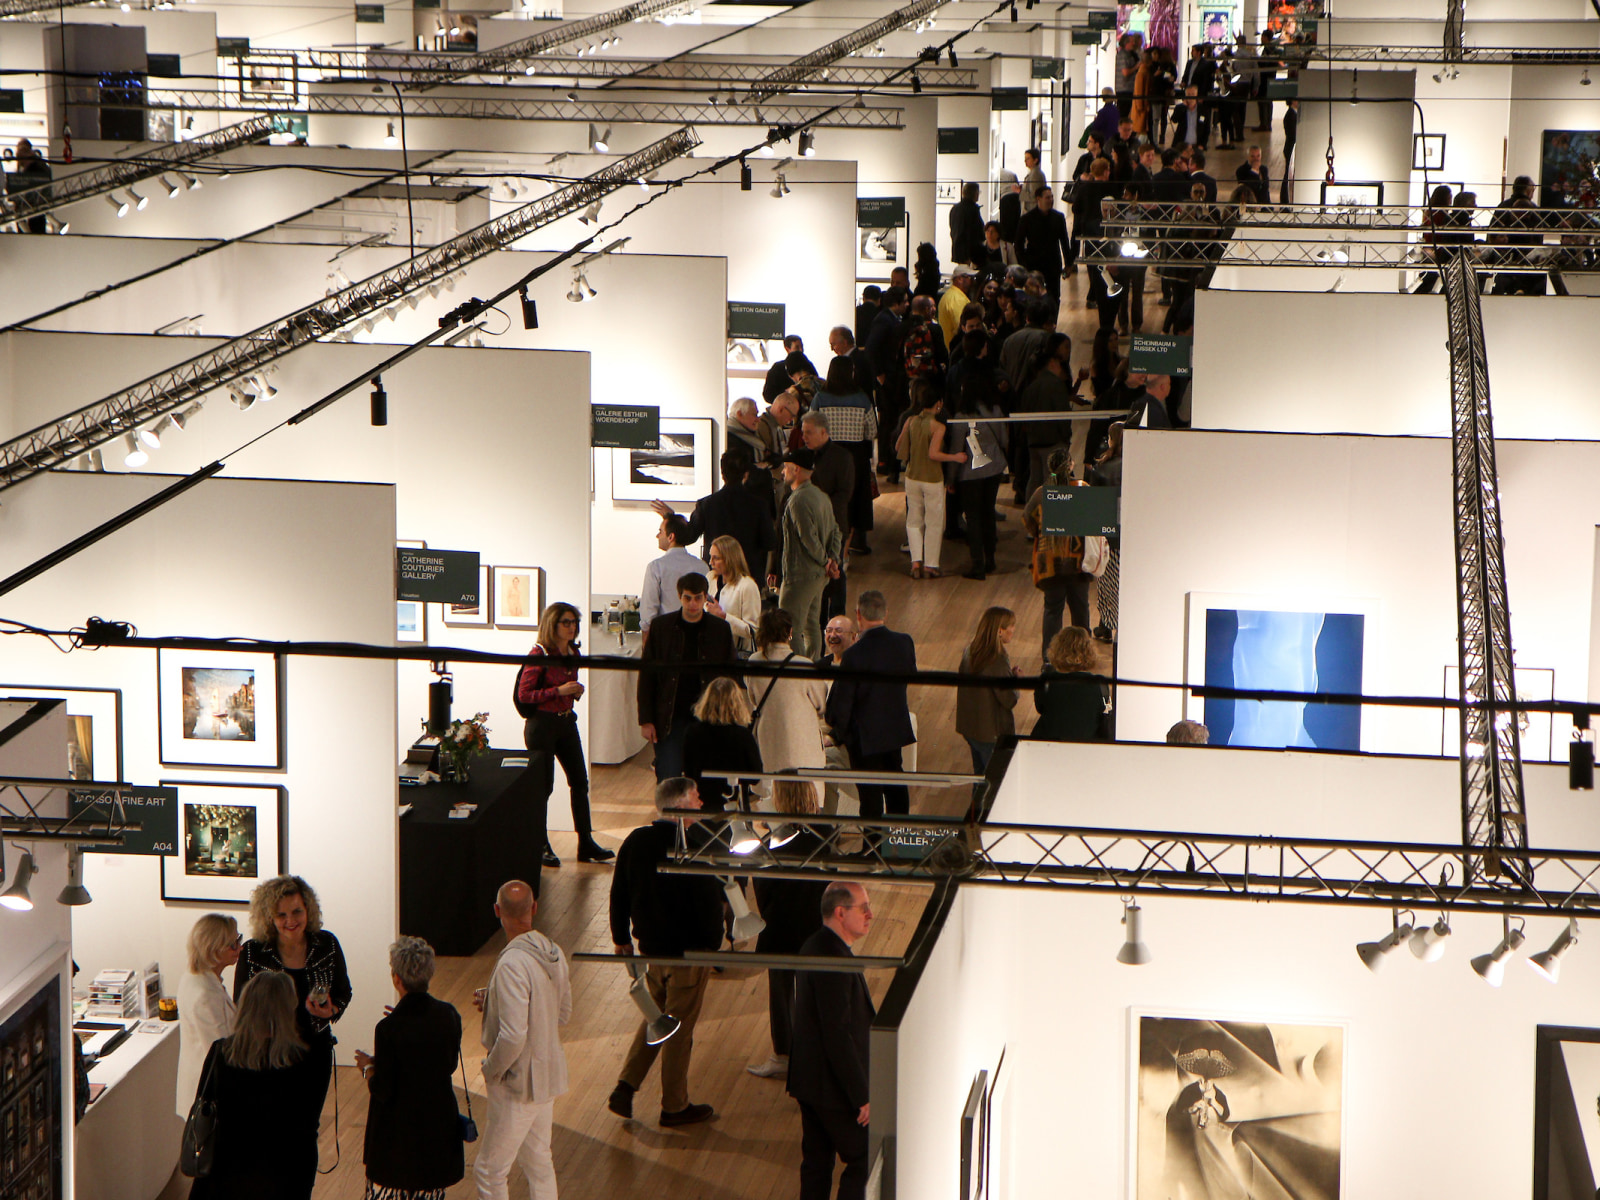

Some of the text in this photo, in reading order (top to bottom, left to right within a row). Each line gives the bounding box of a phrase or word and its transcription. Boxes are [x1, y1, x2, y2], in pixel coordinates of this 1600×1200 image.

[595, 416, 640, 424] WOERDEHOFF
[401, 556, 444, 565] CATHERINE
[401, 564, 445, 573] COUTURIER
[401, 572, 436, 580] GALLERY
[461, 594, 476, 602] A70
[122, 796, 144, 806] FINE
[146, 797, 167, 807] ART
[152, 842, 173, 851] A04
